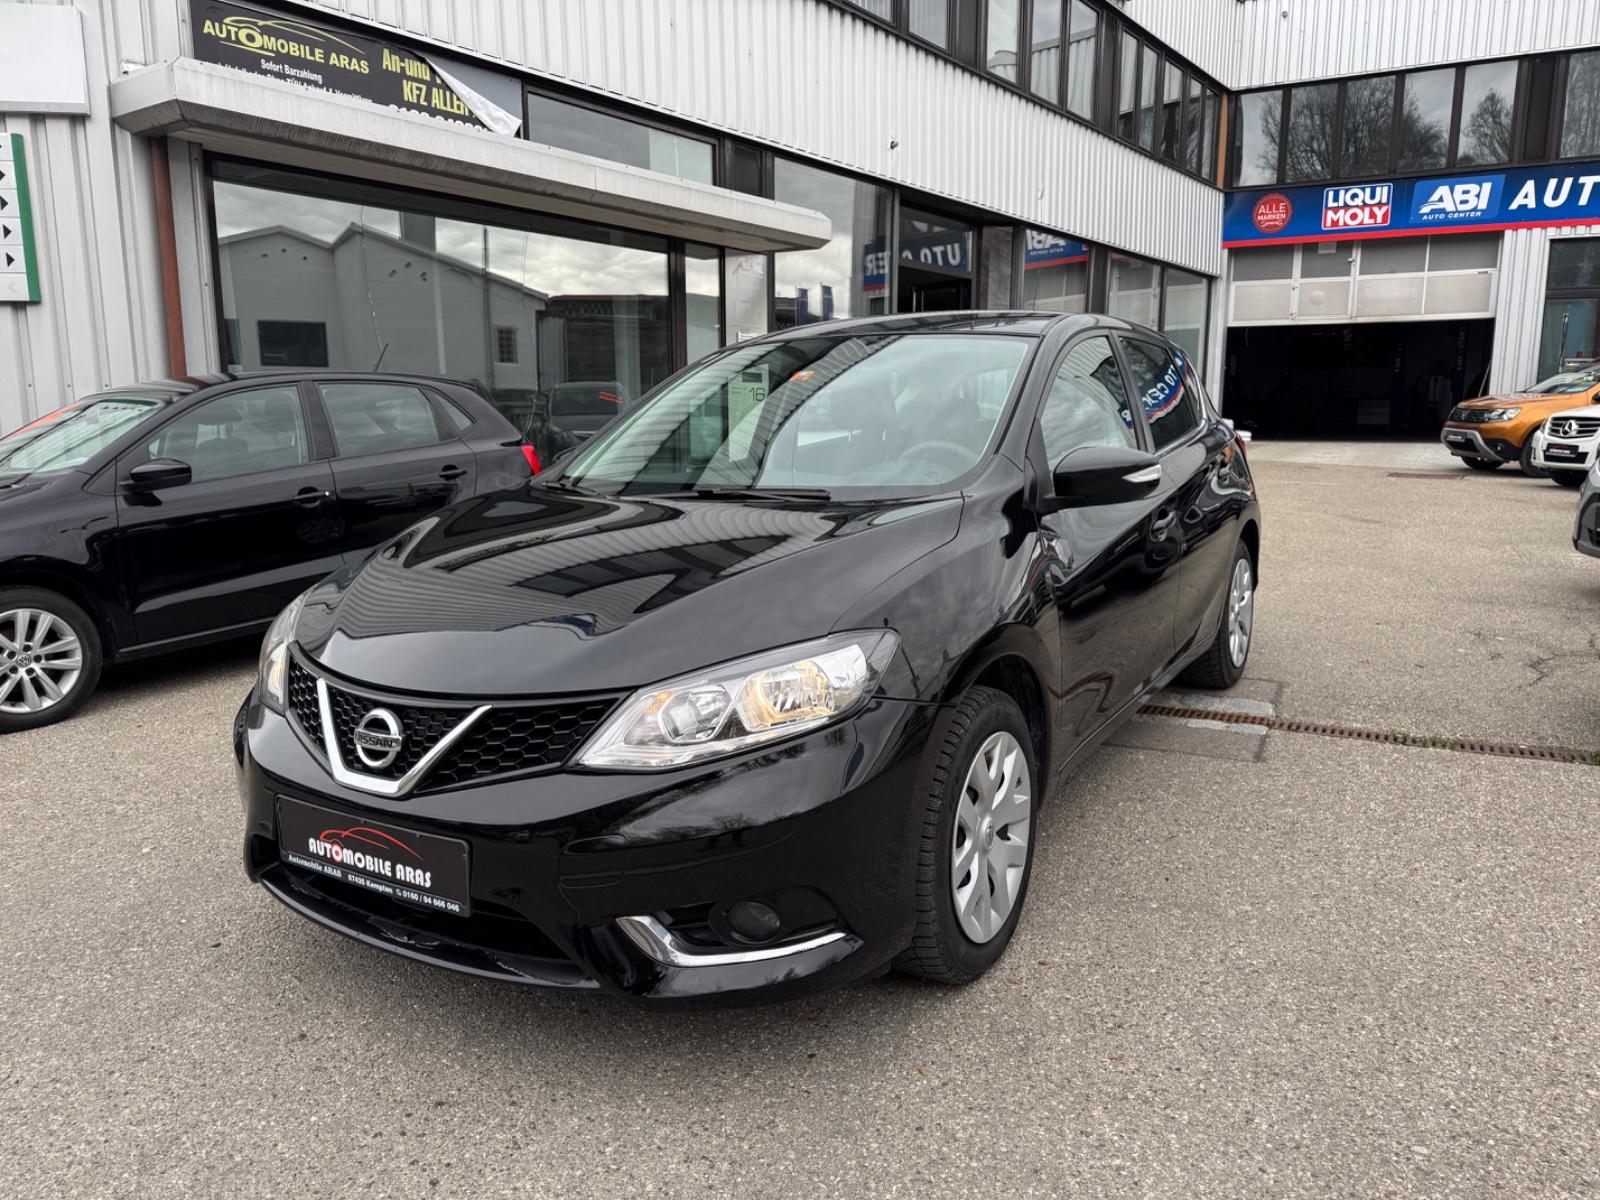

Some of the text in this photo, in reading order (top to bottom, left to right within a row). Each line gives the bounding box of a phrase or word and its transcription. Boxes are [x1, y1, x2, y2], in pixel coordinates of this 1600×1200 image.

[203, 19, 370, 74] AUTOMOBILE ARAS
[260, 59, 284, 73] Sofort
[284, 64, 323, 84] Barzahlung
[402, 79, 428, 106] KFZ
[1327, 186, 1389, 208] LIQUI
[1418, 182, 1492, 214] ABI
[1508, 175, 1600, 210] AUT
[1258, 202, 1286, 214] ALLE
[1258, 213, 1286, 222] MARKEN
[1325, 205, 1389, 227] MOLY
[1448, 211, 1482, 219] CENTER
[749, 387, 766, 402] 16
[308, 837, 432, 888] AUTOMOBILE ARAS
[402, 890, 419, 901] 0160
[423, 895, 432, 904] 94
